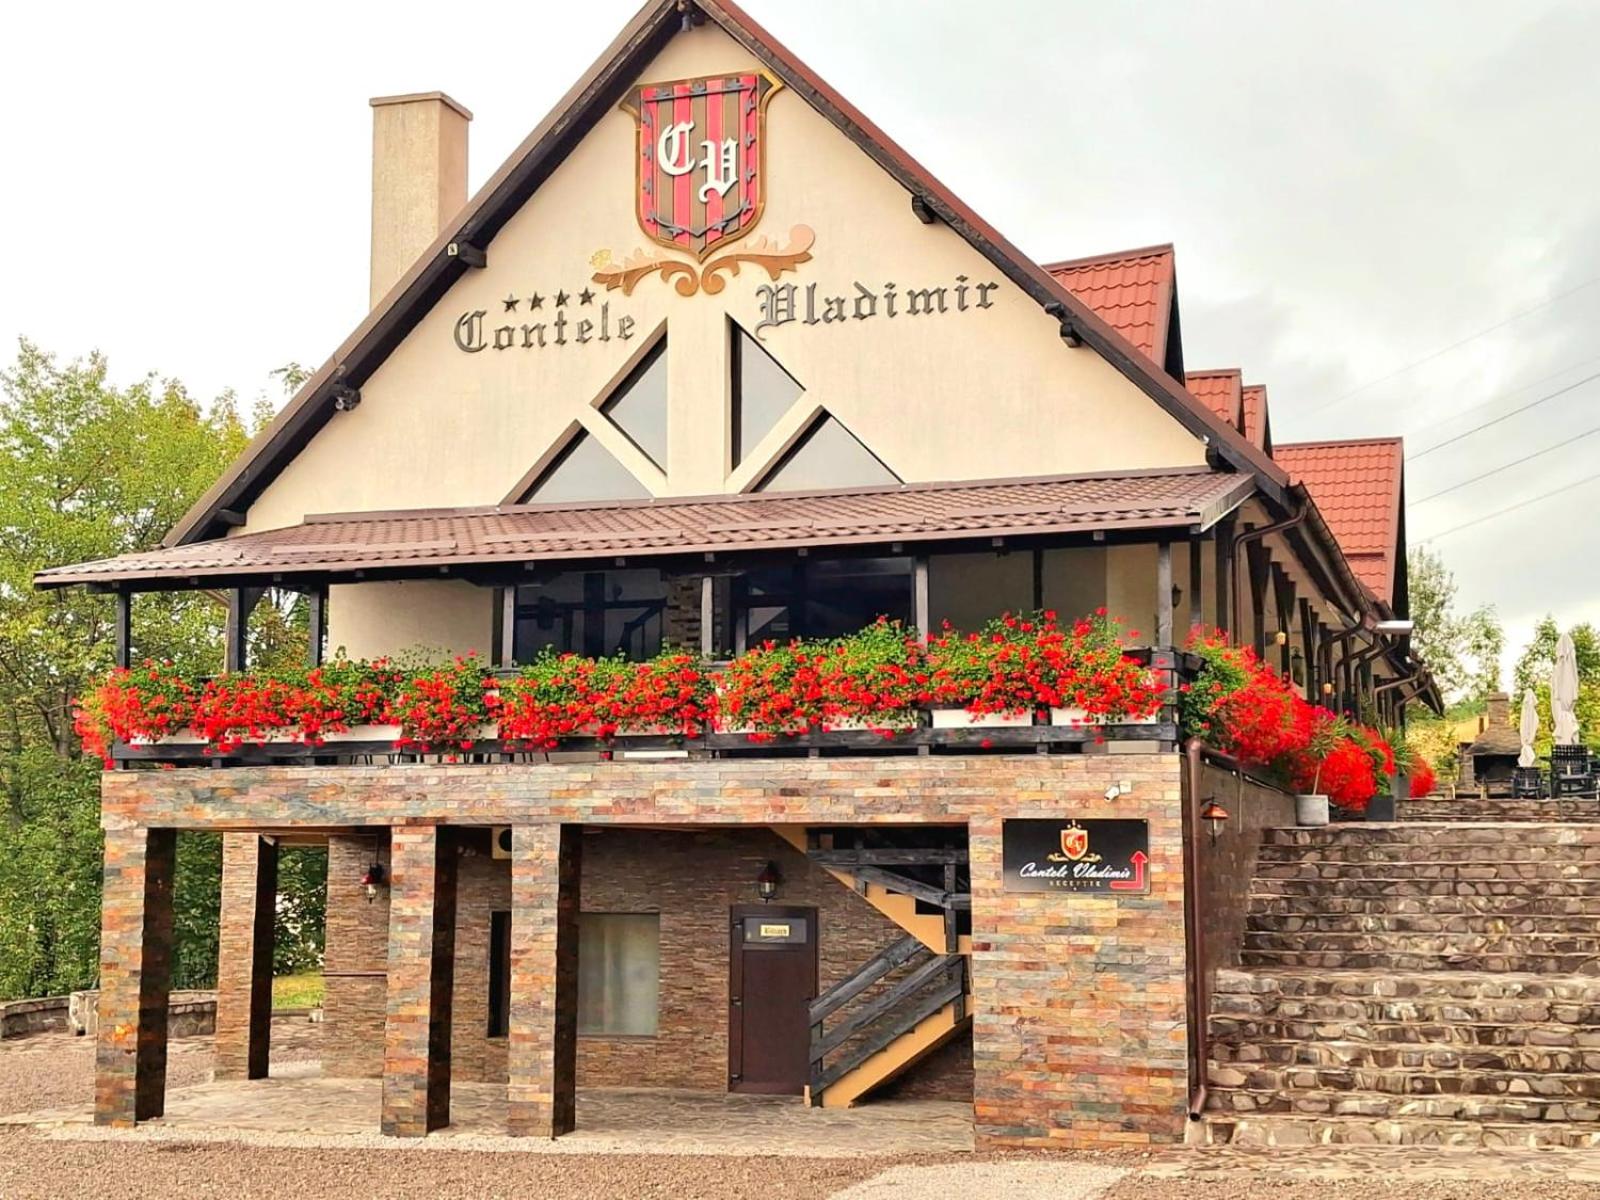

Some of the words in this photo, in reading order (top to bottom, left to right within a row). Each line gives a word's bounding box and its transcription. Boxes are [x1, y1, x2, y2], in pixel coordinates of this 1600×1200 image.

[453, 301, 637, 354] Contele
[754, 274, 1000, 342] Vladimir
[1019, 861, 1068, 878] Contele
[1073, 862, 1131, 879] Vladimir
